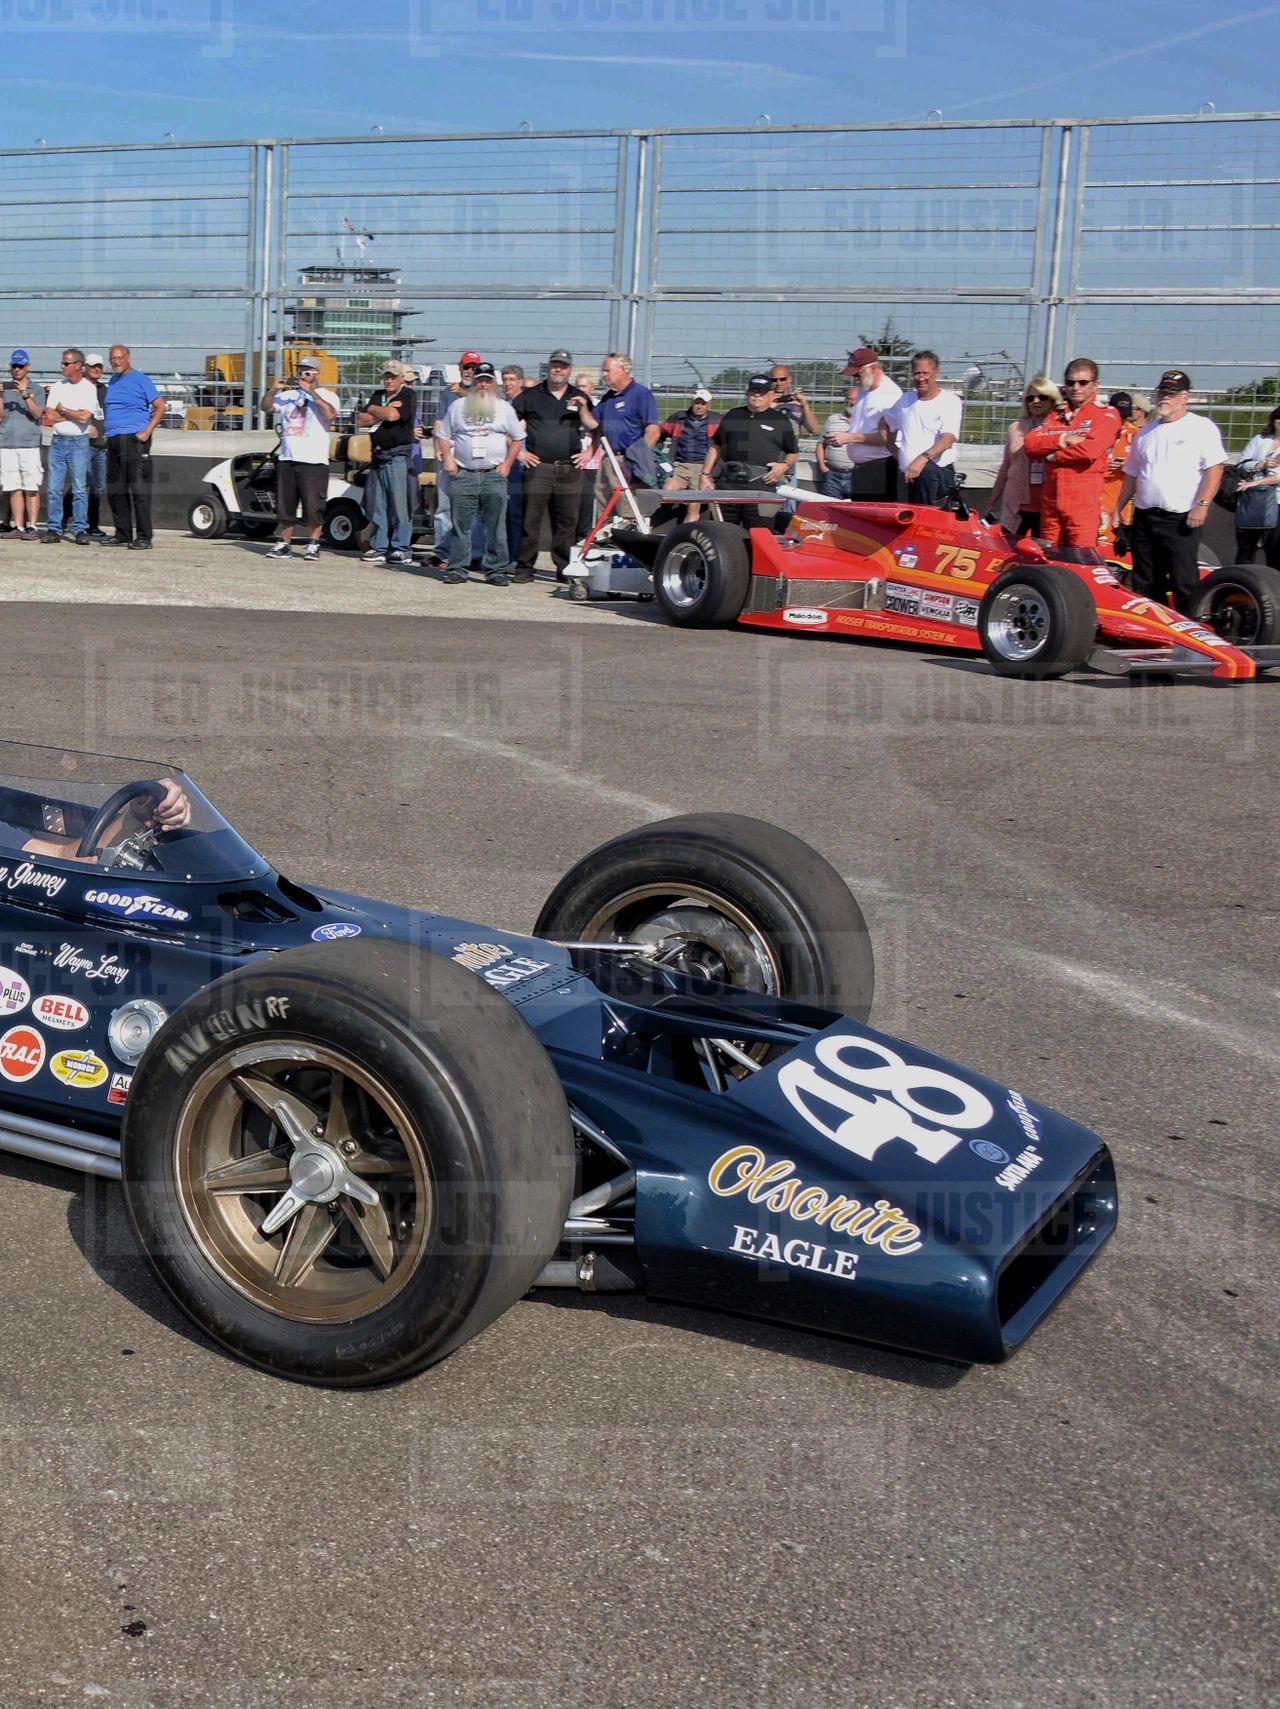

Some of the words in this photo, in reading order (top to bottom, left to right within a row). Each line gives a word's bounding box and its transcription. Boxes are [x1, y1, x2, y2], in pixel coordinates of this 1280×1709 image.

[934, 544, 982, 579] 75
[924, 593, 951, 605] SIMPSON
[836, 615, 864, 628] HOOSIER
[864, 620, 917, 637] TRANSPORTATION
[917, 629, 944, 642] SYSTEM
[7, 862, 68, 897] Gurney
[84, 889, 191, 922] GOODYEAR
[321, 924, 355, 940] Ford
[53, 942, 94, 973] Wayne
[85, 955, 130, 985] Leary
[2, 987, 26, 1003] PLUS
[265, 996, 291, 1021] RF
[39, 998, 84, 1023] BELL
[41, 1015, 76, 1028] HELMETS
[777, 1034, 994, 1164] 48
[708, 1144, 923, 1257] Olsonite
[729, 1224, 860, 1281] EAGLE
